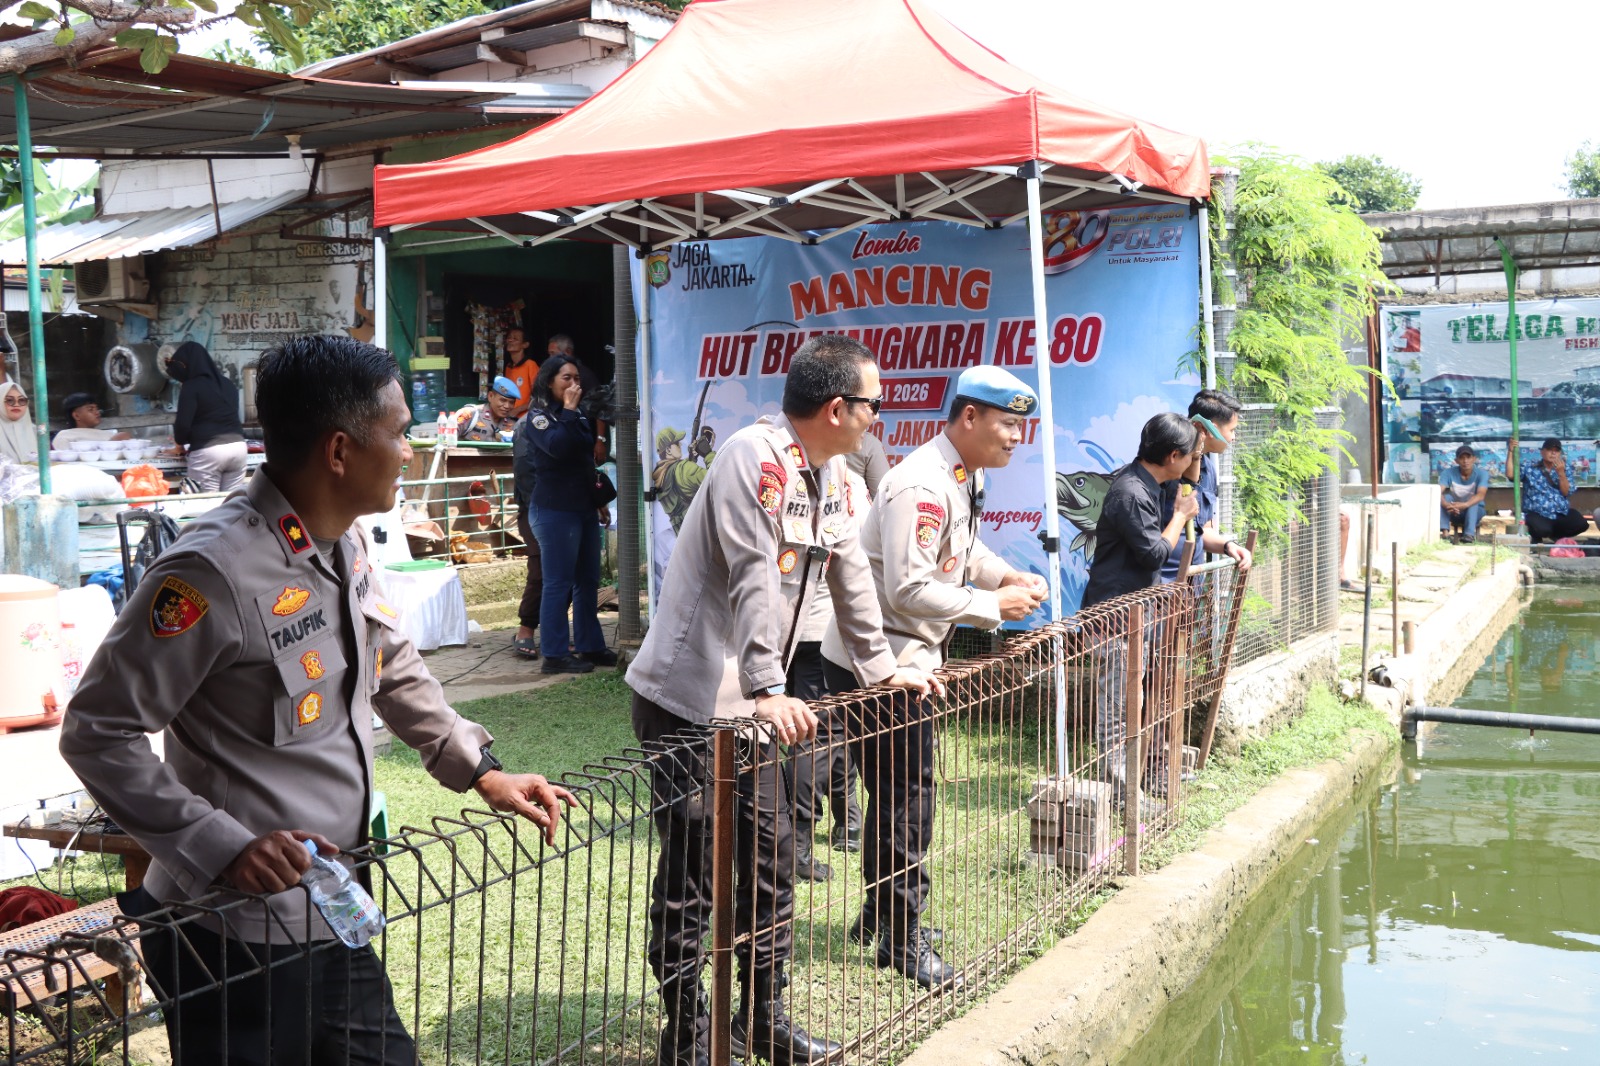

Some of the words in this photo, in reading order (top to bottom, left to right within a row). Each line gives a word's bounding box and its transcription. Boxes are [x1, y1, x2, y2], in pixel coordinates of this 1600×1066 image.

[852, 230, 921, 260] Lomba
[1106, 226, 1185, 252] POLRI
[672, 242, 712, 269] JAGA
[1108, 257, 1132, 265] Untuk
[1133, 254, 1179, 264] Masyarakat
[789, 264, 991, 321] MANCING
[221, 313, 260, 330] MANG
[264, 311, 301, 330] JAJA
[1447, 314, 1567, 342] TELAGA
[699, 333, 759, 379] HUT
[993, 316, 1102, 366] KE80
[892, 383, 930, 403] 2026
[168, 579, 207, 611] RESERSE
[271, 608, 327, 650] TAUFIK
